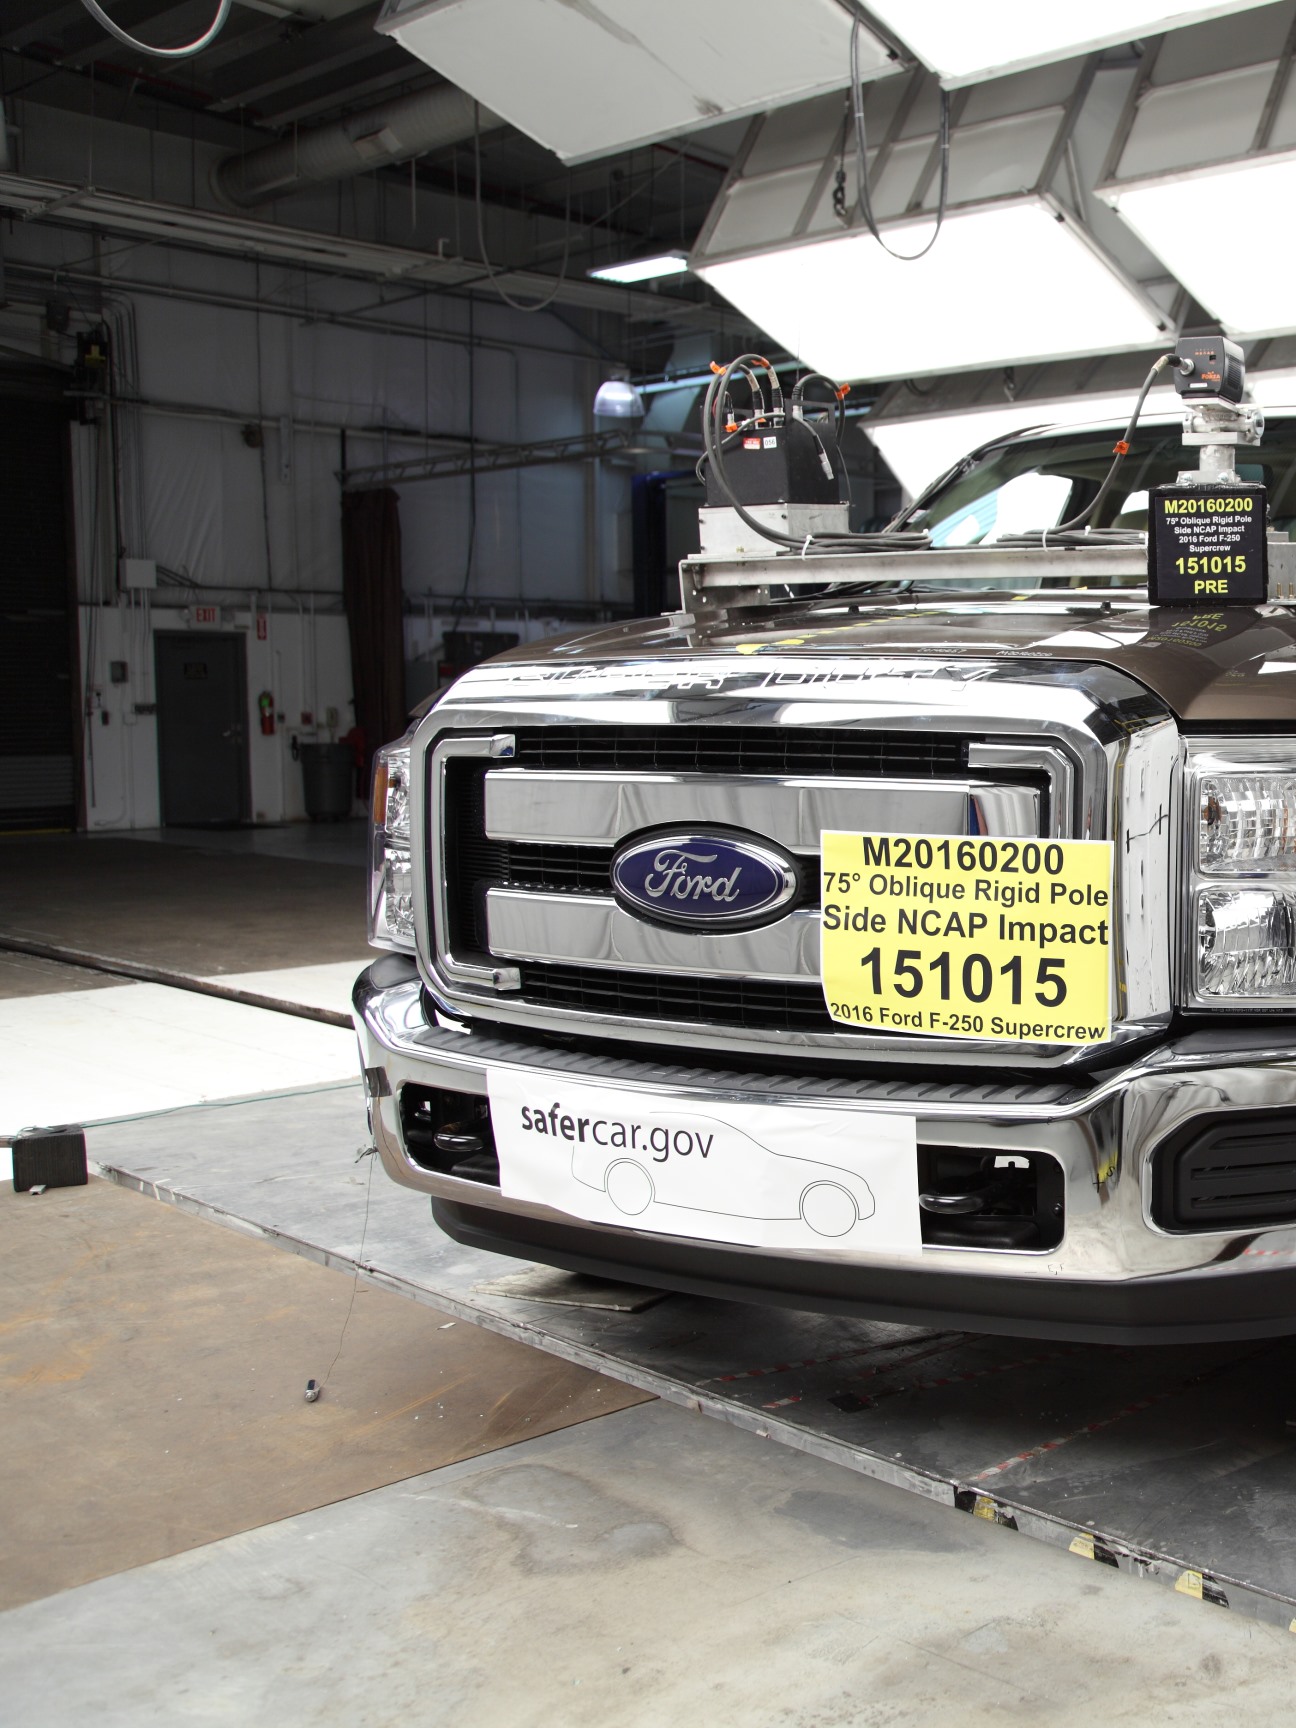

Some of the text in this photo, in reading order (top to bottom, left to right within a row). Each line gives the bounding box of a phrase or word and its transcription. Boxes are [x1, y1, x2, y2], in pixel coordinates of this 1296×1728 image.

[1164, 498, 1253, 514] M20160200
[1174, 525, 1245, 534] Side NCAP Impact
[1180, 516, 1211, 526] Oblique
[1212, 515, 1233, 525] Rigid
[1234, 515, 1252, 523] Pole
[1178, 534, 1241, 544] 2016 Ford F-250
[1189, 544, 1231, 553] Supercrew
[1175, 556, 1247, 575] 151015
[1194, 579, 1228, 594] PRE
[196, 607, 216, 622] EXIT
[862, 836, 1065, 875] M20160200
[644, 850, 743, 902] Ford
[823, 872, 1109, 908] 75° Oblique Rigid Pole
[823, 904, 1109, 949] Side NCAP Impact
[860, 947, 1068, 1008] 151015
[830, 1002, 1106, 1040] 2016 Ford F-250 Supercrew
[521, 1102, 714, 1163] safercar.gov
